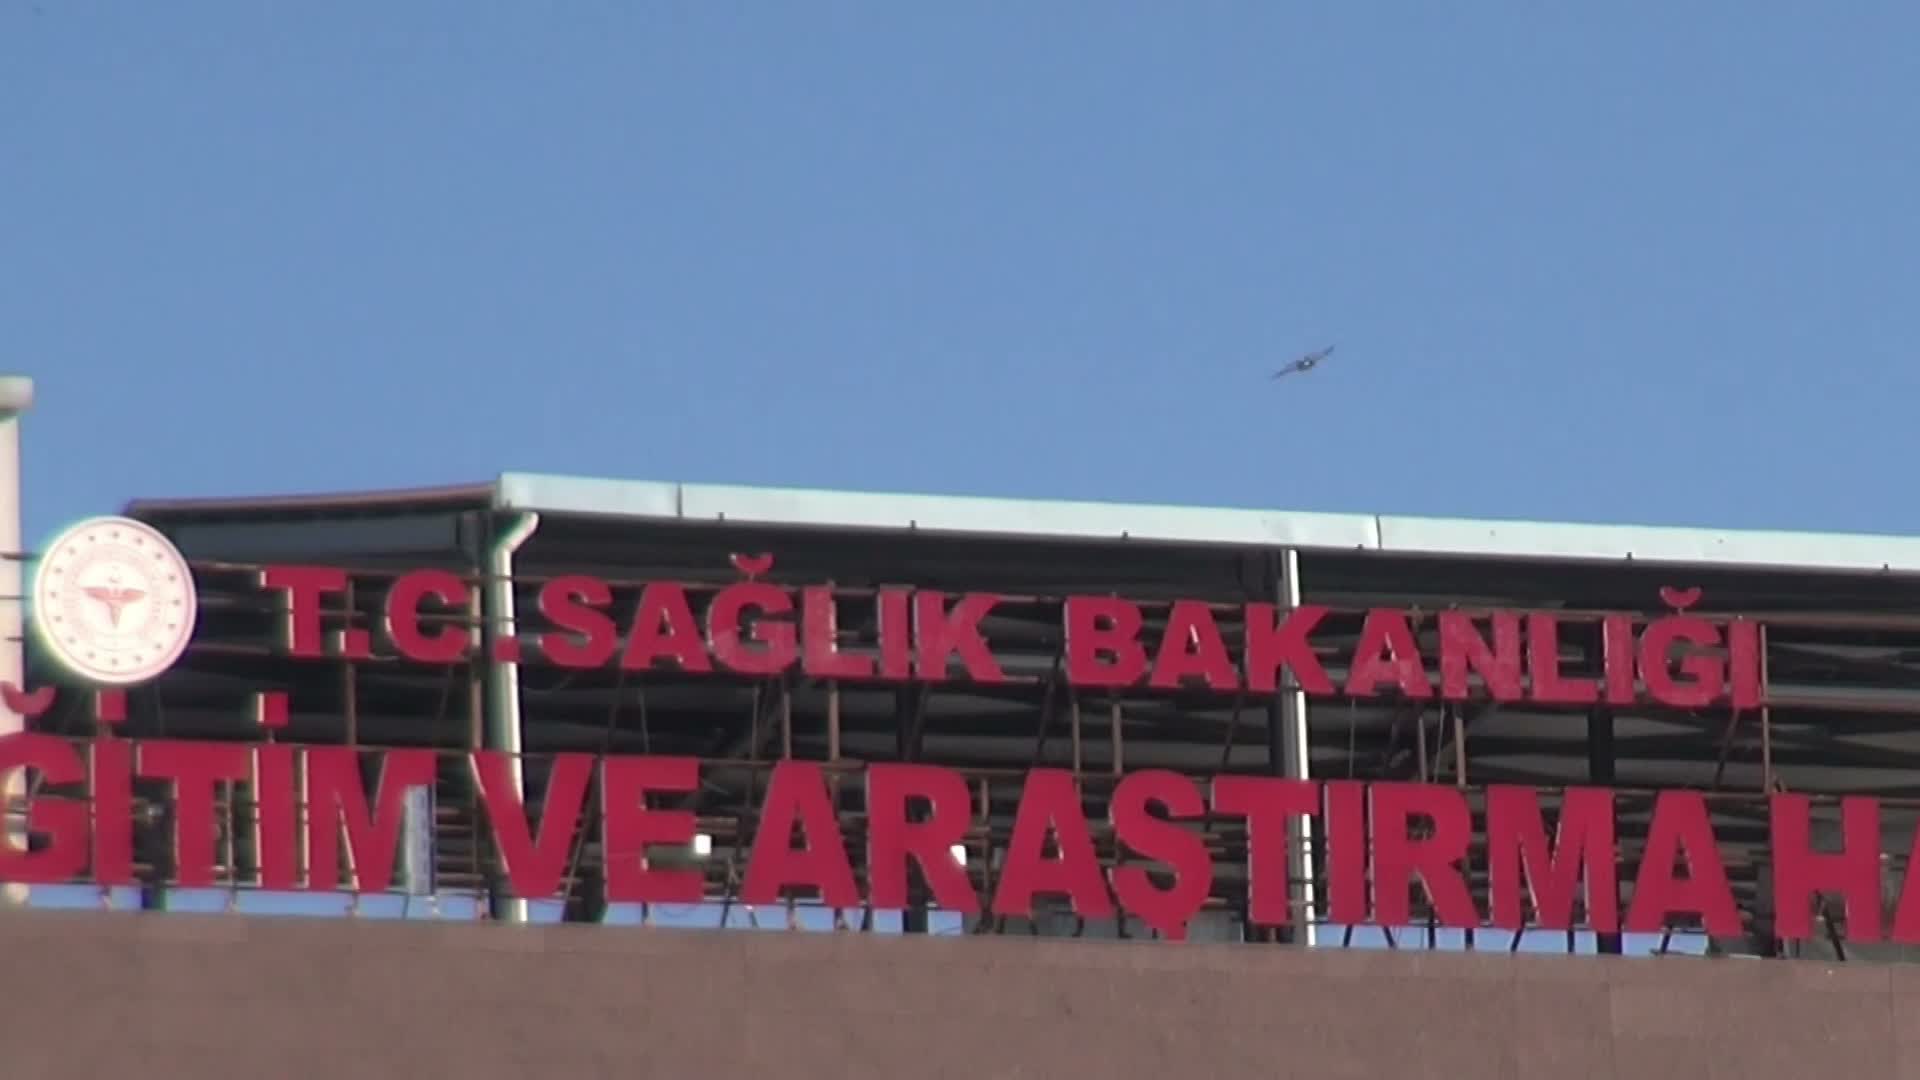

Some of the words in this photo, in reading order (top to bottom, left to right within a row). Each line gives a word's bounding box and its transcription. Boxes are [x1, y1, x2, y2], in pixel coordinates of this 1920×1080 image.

[538, 553, 1002, 683] SAĞLIK
[1063, 587, 1762, 711] BAKANLIĞI
[469, 749, 705, 905] VE
[738, 758, 1744, 942] ARAŞTIRMA
[1768, 792, 1920, 944] H
